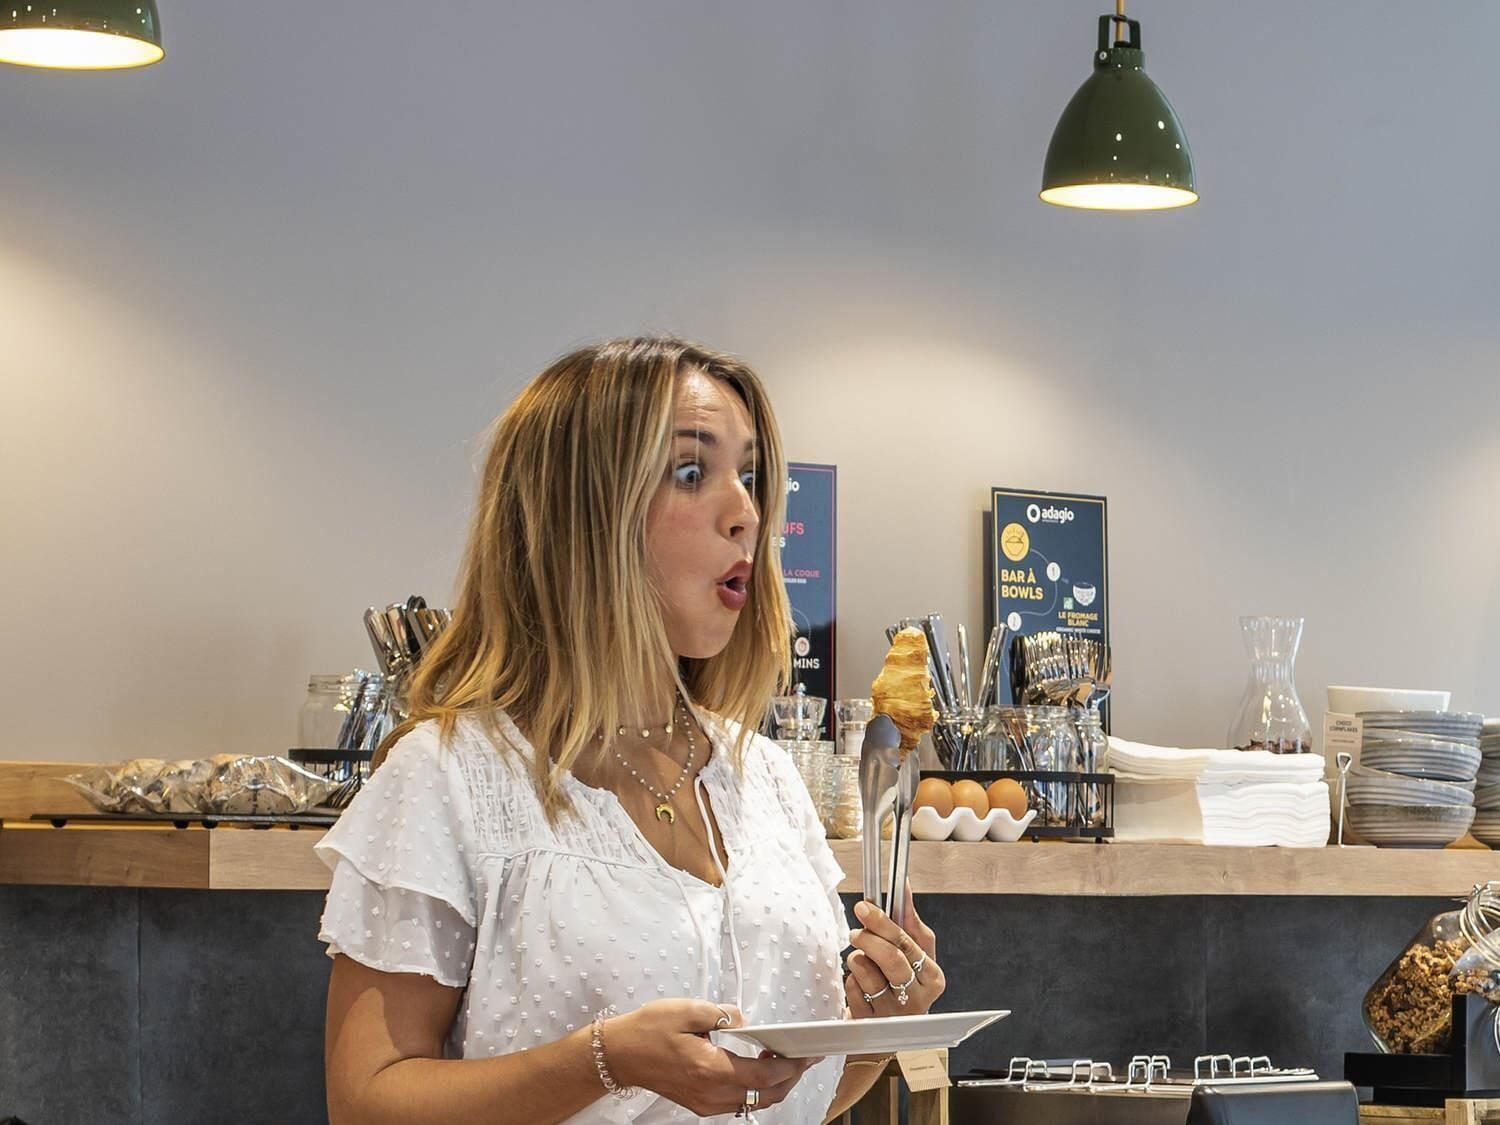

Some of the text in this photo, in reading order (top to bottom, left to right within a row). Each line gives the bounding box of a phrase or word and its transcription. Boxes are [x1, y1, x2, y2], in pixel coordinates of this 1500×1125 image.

[1042, 506, 1074, 524] adagio
[794, 569, 820, 578] COQUE
[1001, 567, 1036, 584] BAR À
[1001, 585, 1044, 600] BOWLS
[793, 657, 820, 669] MINS
